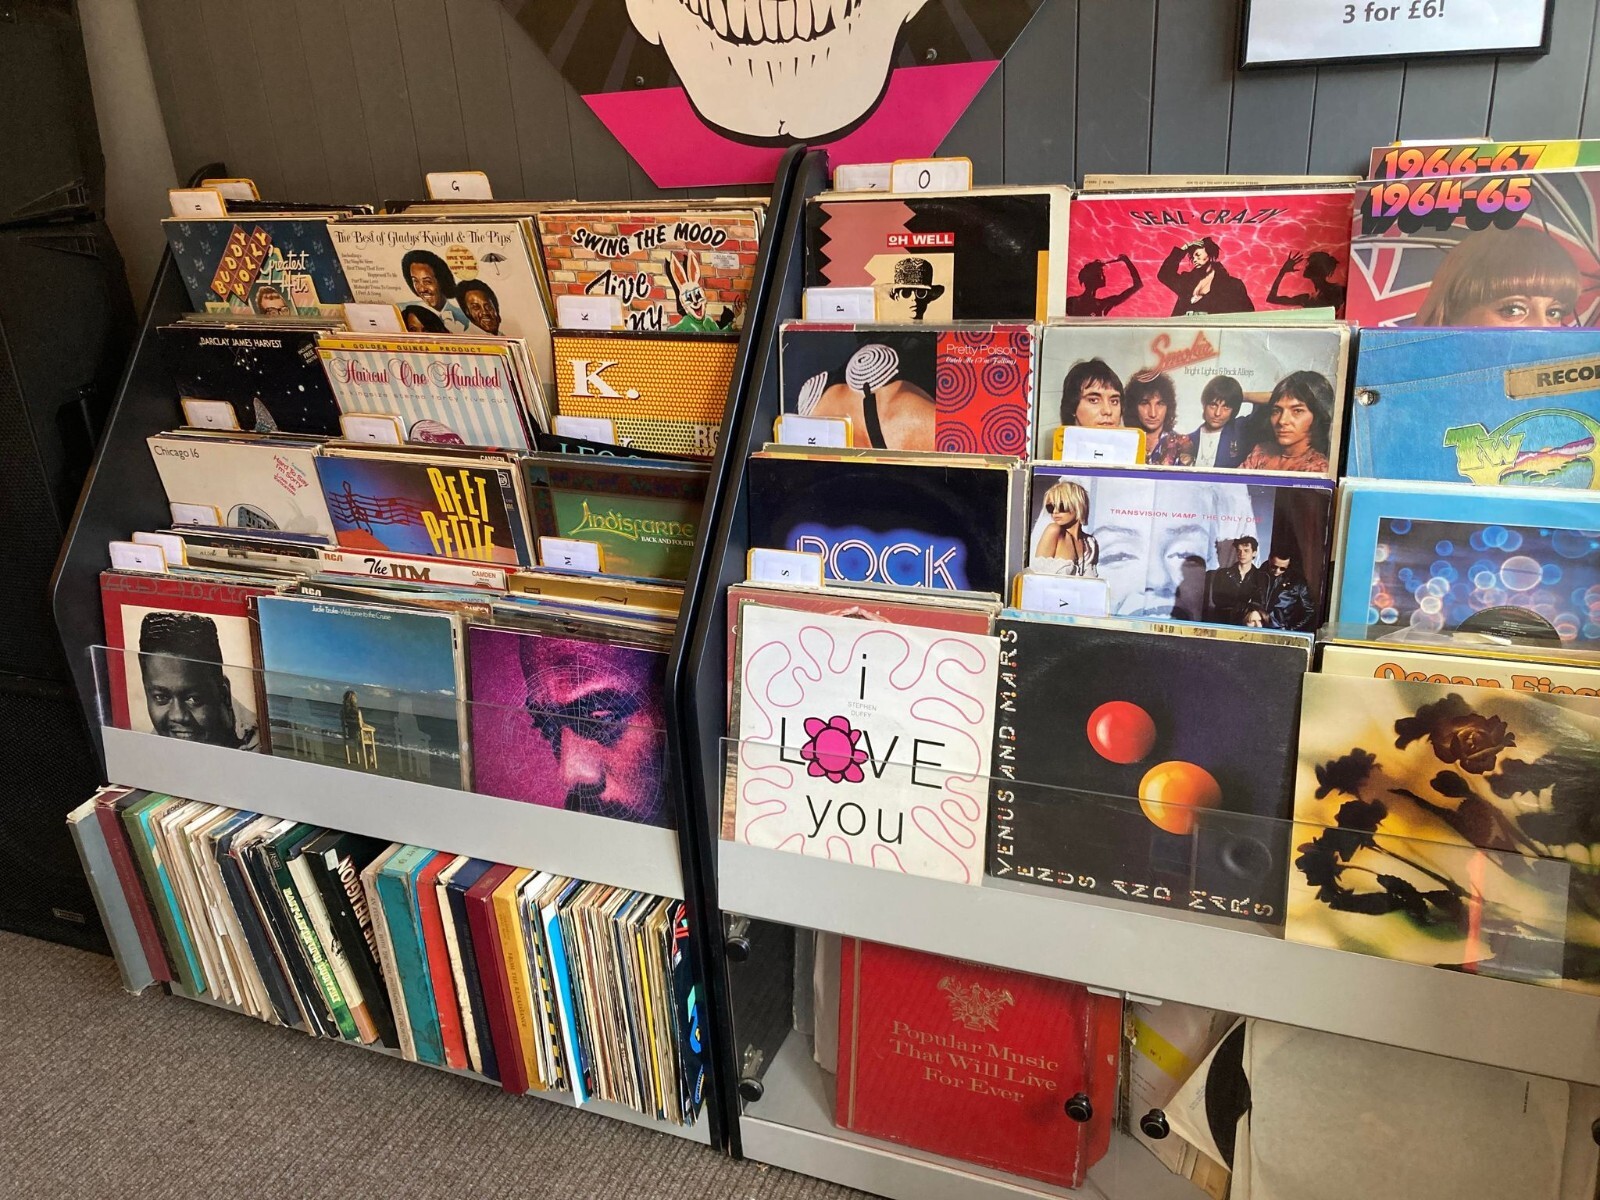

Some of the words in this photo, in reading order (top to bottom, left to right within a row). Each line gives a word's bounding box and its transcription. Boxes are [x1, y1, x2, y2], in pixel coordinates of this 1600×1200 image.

[1343, 4, 1356, 24] 3
[1364, 1, 1401, 23] for
[1407, 0, 1445, 20] £6!
[1385, 145, 1547, 179] 1966-67
[1369, 178, 1532, 217] 1964-65
[1129, 210, 1189, 226] SEAL
[1200, 207, 1289, 225] CRAZY
[335, 230, 351, 243] The
[352, 231, 374, 249] Best
[376, 231, 386, 246] of
[388, 231, 421, 250] Gladys
[420, 231, 454, 247] Knight
[456, 231, 466, 243] &
[467, 230, 485, 243] The
[485, 230, 515, 248] Pips
[573, 228, 631, 256] SWING
[634, 224, 667, 250] THE
[674, 222, 728, 247] MOOD
[888, 235, 909, 246] OH
[912, 234, 953, 245] WELL
[215, 232, 246, 294] BUDDY
[233, 232, 266, 296] HOLLY
[581, 312, 589, 321] K
[200, 336, 229, 346] BARCLAY
[231, 338, 253, 347] JAMES
[254, 339, 282, 348] HARVEST
[946, 344, 978, 356] Pretty
[980, 344, 1017, 355] Poison
[329, 357, 389, 386] Haircut
[388, 358, 428, 388] One
[428, 361, 501, 390] Hundred
[568, 359, 640, 400] K.
[153, 445, 189, 460] Chicago
[189, 447, 199, 458] 16
[808, 437, 816, 445] R
[427, 467, 489, 522] REET
[1110, 508, 1168, 517] TRANSVISION
[420, 511, 495, 562] PETITE
[641, 536, 657, 544] BACK
[323, 553, 343, 562] RCA
[364, 557, 388, 575] The
[472, 570, 496, 579] CAMDEN
[301, 587, 322, 597] RCA
[860, 653, 867, 700] i
[999, 629, 1018, 713] MARS
[848, 701, 877, 711] STEPHEN
[998, 725, 1017, 781] AND
[805, 795, 904, 845] you
[996, 789, 1015, 876] VENUS
[334, 857, 373, 928] RELIGION
[1110, 878, 1172, 901] AND
[1188, 889, 1275, 917] MARS
[892, 1020, 982, 1054] Popular
[987, 1043, 1060, 1072] Music
[889, 1038, 943, 1065] That
[947, 1052, 1000, 1079] Will
[1004, 1066, 1058, 1091] Live
[922, 1066, 965, 1089] For
[969, 1077, 1026, 1103] Ever
